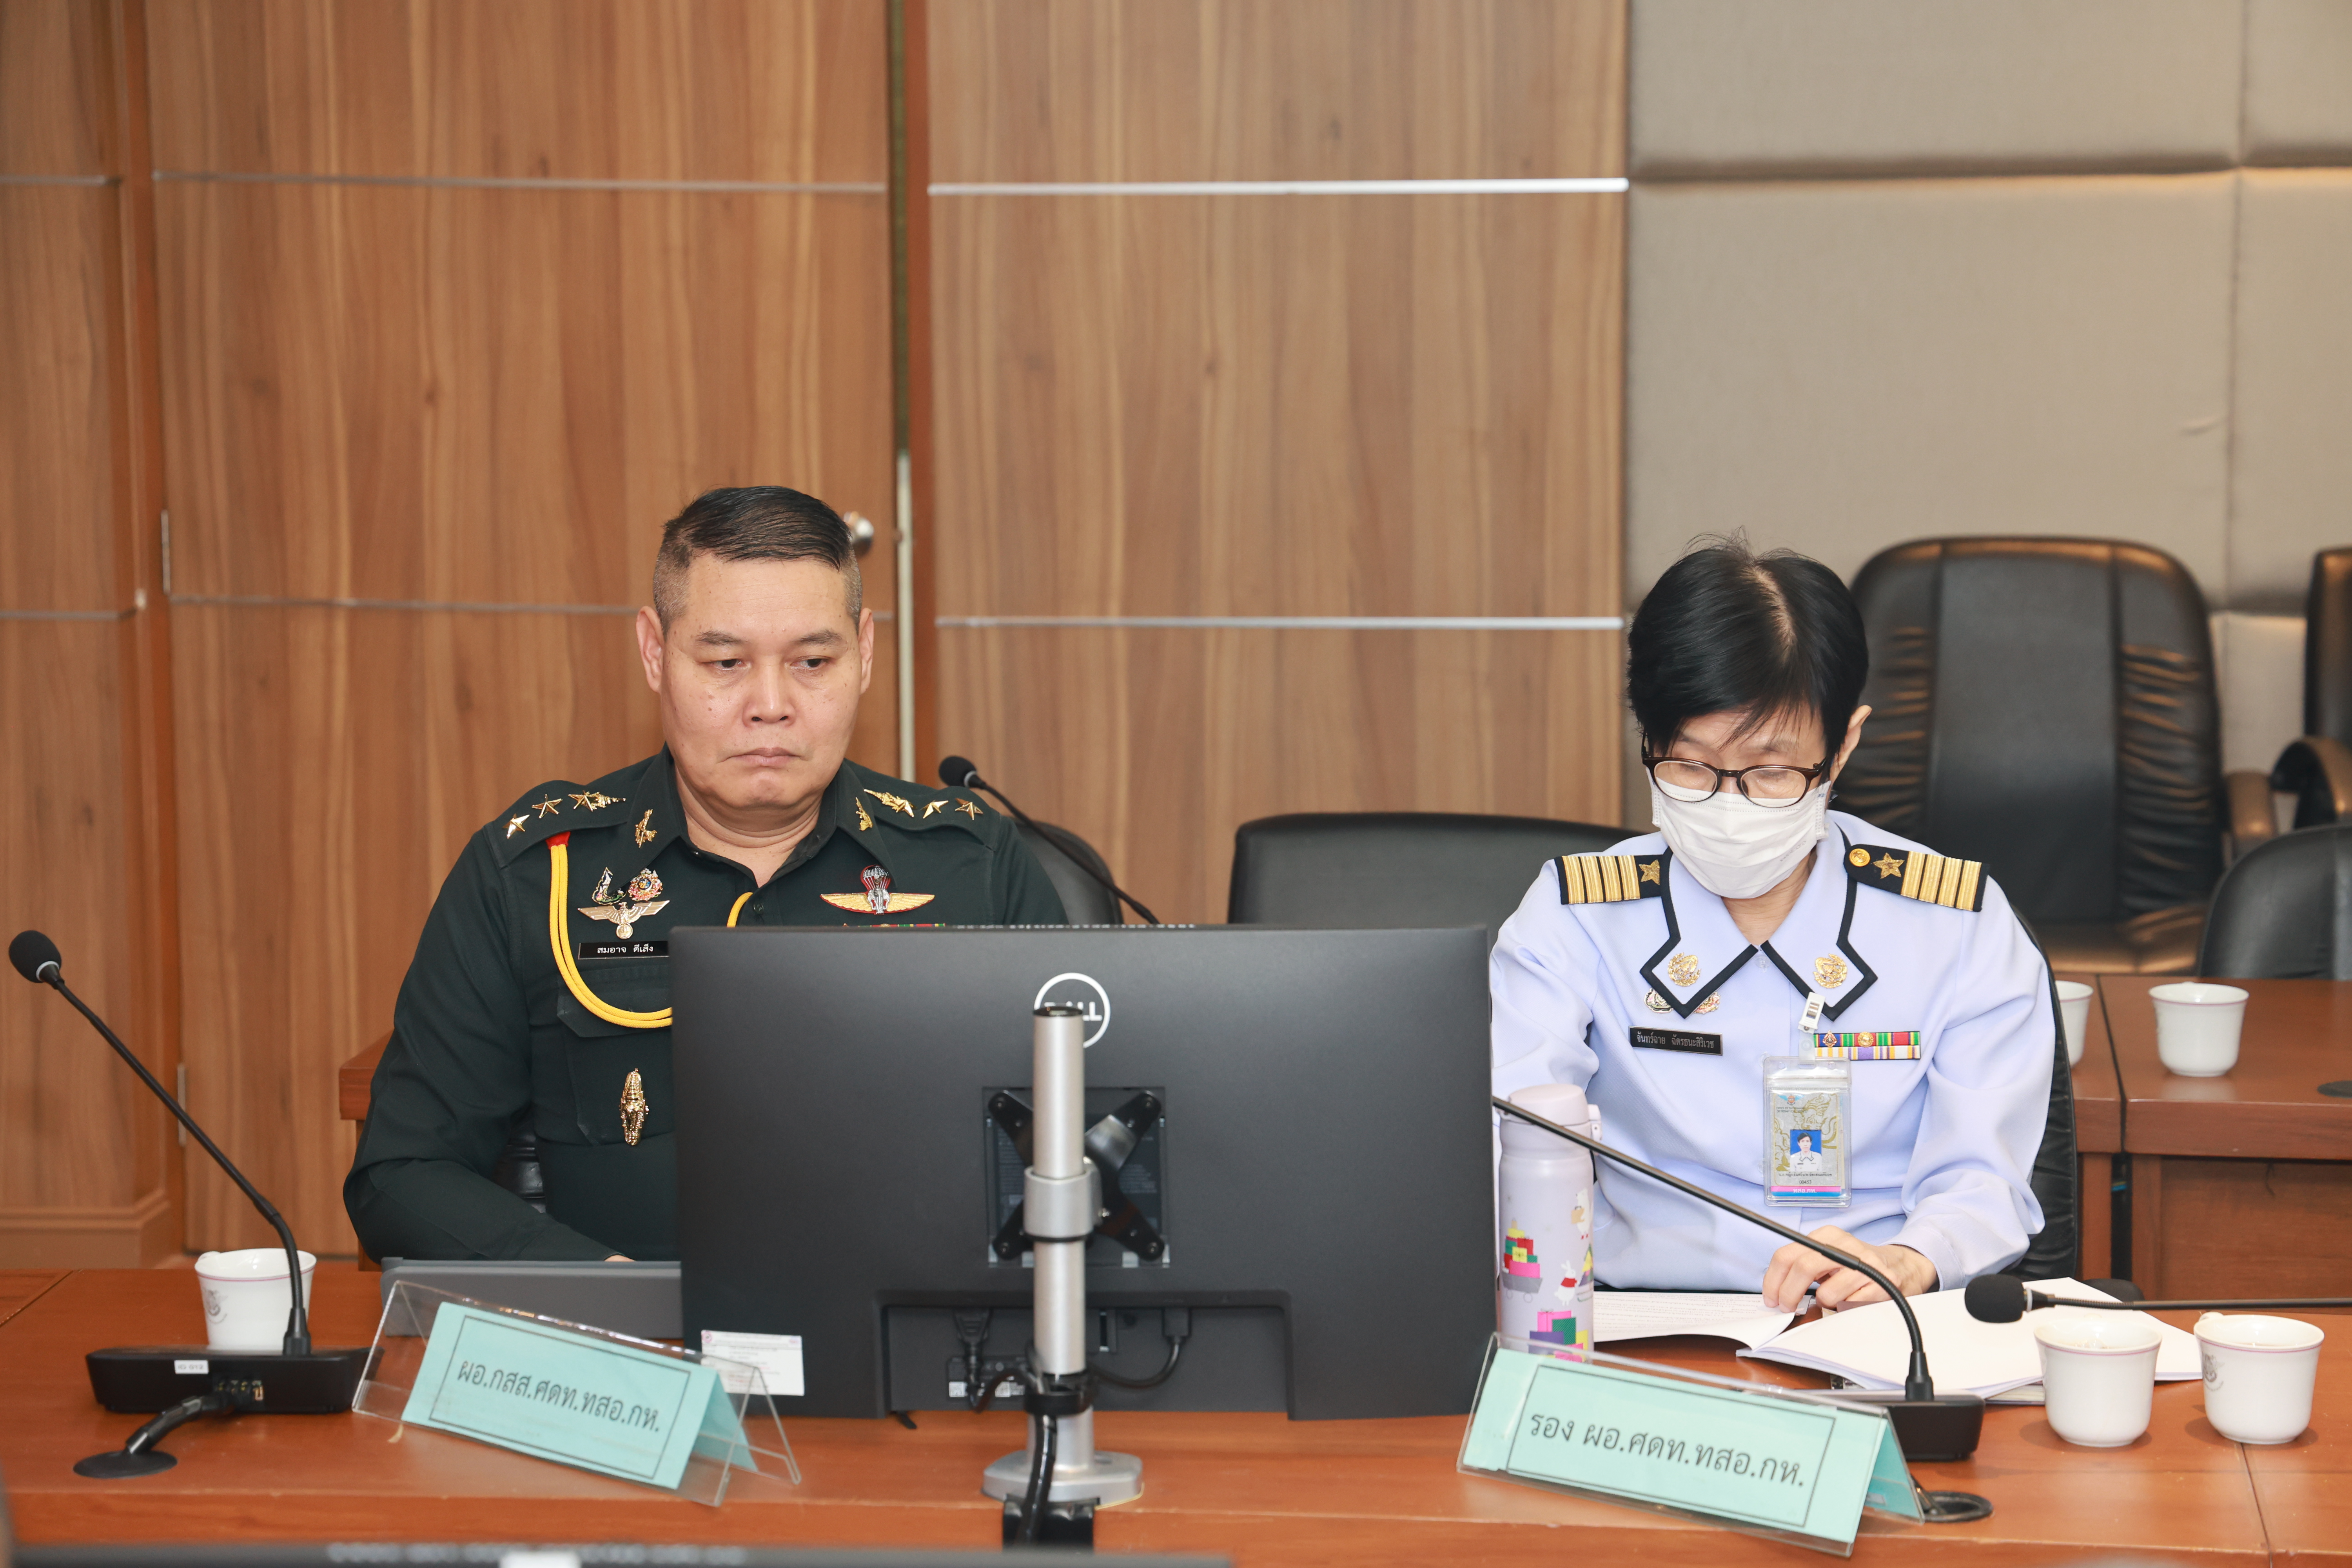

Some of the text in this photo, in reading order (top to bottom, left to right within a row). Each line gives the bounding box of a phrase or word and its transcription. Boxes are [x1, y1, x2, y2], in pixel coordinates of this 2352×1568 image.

[1636, 1031, 1666, 1044] จันทร์ฉาย
[457, 1360, 659, 1432] ผอ.กสส.ศดท.ทสอ.กห.
[1530, 1414, 1804, 1487] รอง ผอ.ศดท.ทสอ.กห.
